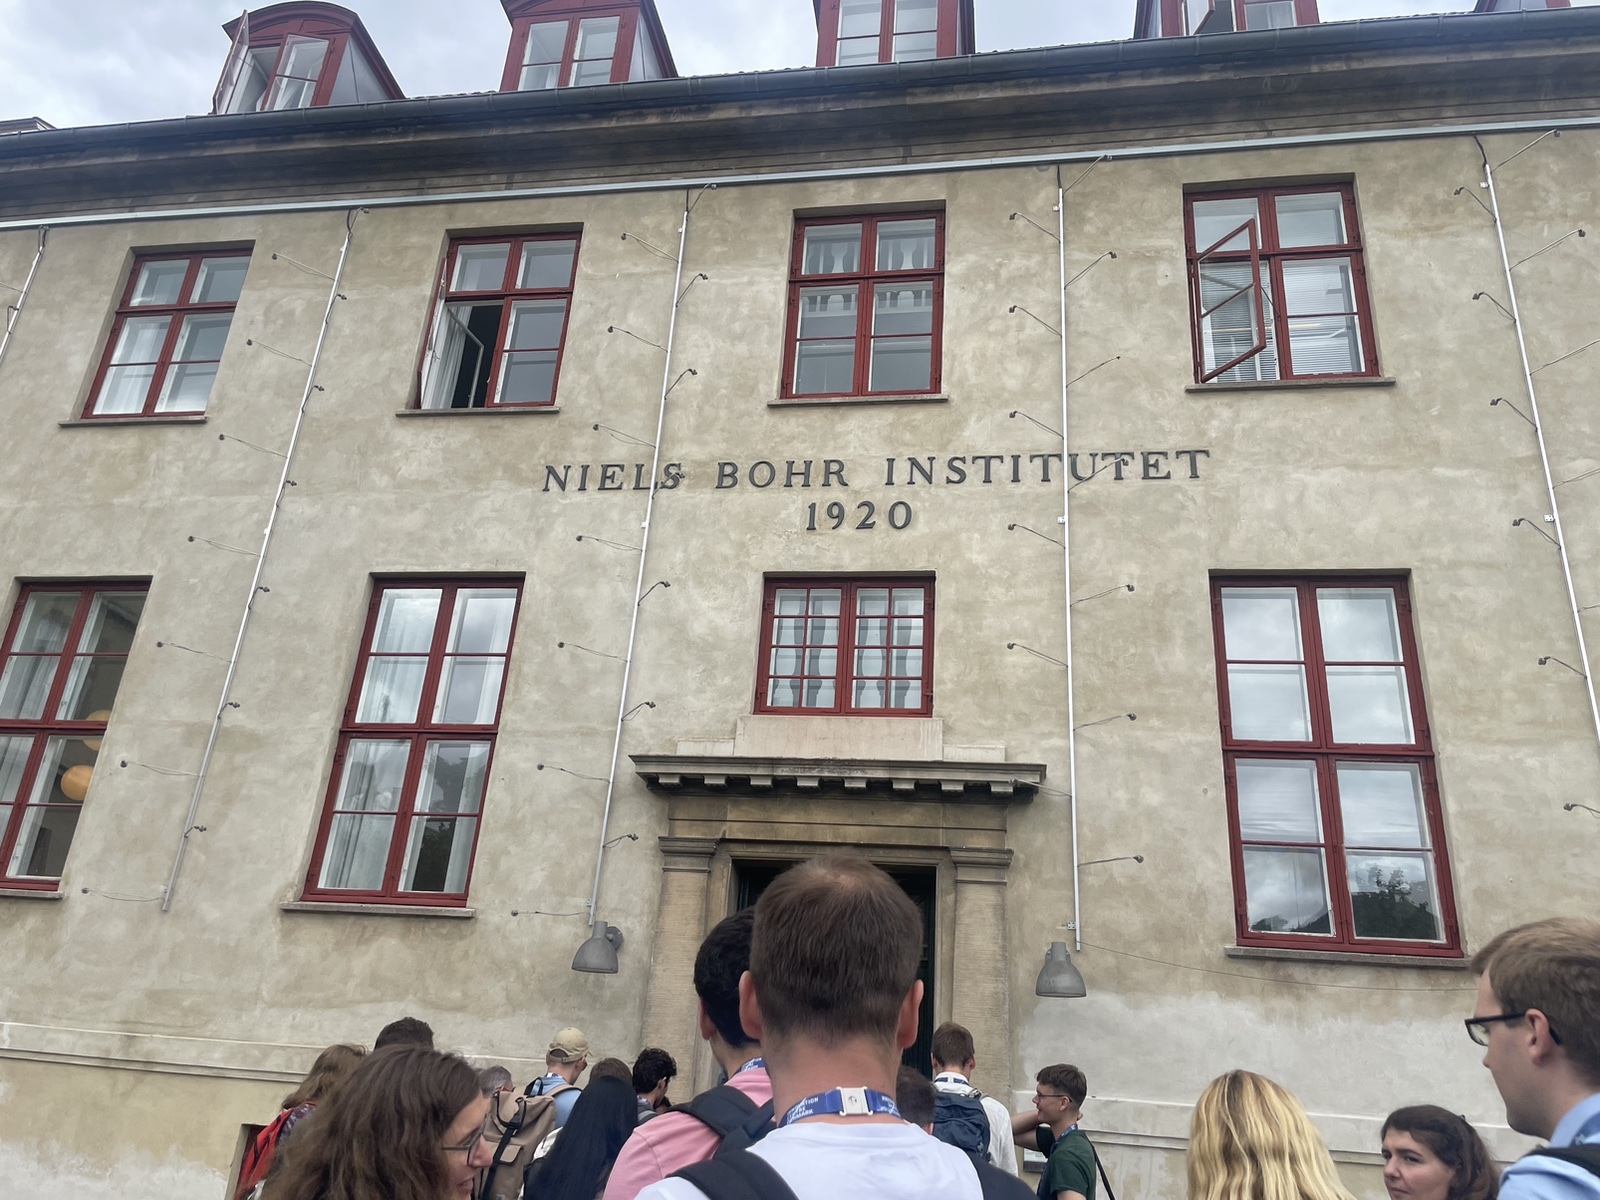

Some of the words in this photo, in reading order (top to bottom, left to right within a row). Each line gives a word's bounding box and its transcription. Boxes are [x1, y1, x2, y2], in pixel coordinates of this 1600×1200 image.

[542, 462, 683, 492] NIELS
[715, 459, 849, 490] BOHR
[884, 449, 1210, 486] INSTITUTET
[806, 501, 913, 531] 1920
